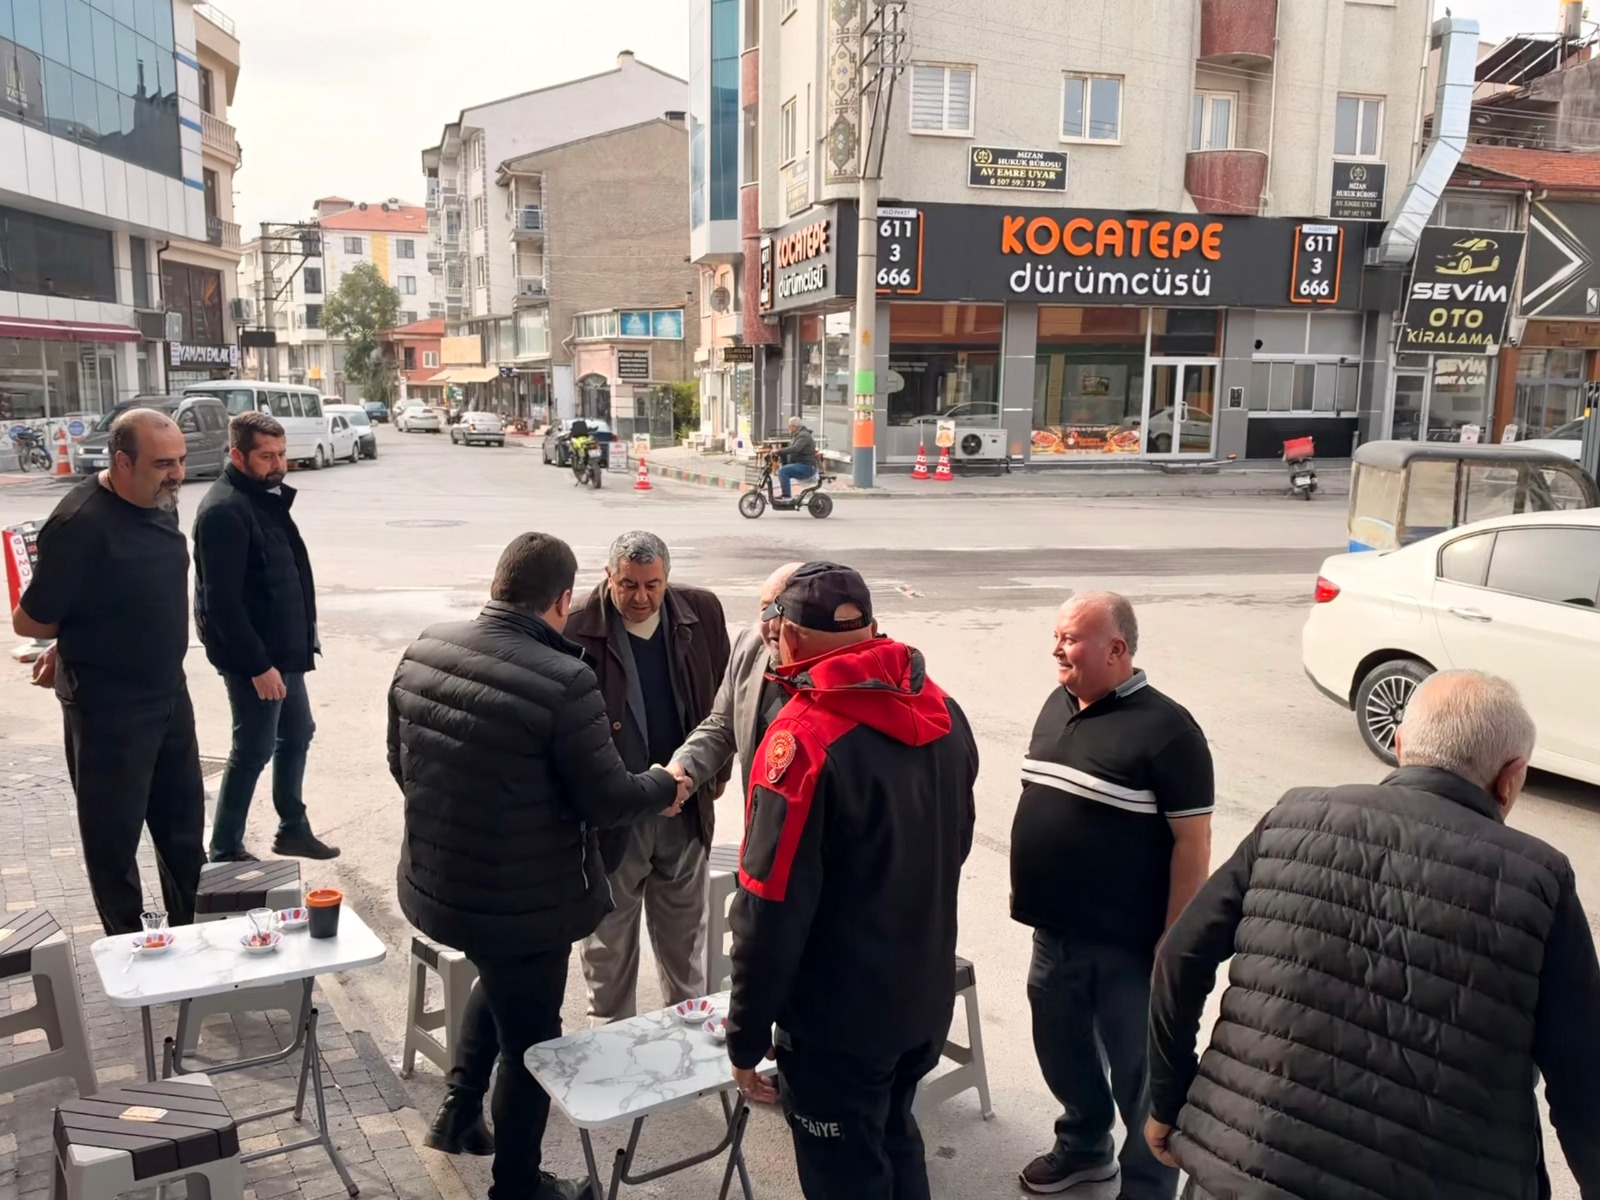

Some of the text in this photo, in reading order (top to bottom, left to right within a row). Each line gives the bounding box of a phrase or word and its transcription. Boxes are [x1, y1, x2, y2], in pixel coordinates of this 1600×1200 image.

[998, 158, 1061, 168] HUKUK BÜROSU
[1017, 151, 1044, 159] MİZAN
[997, 168, 1026, 178] EMRE
[1028, 170, 1056, 179] UYAR
[997, 178, 1010, 186] 507
[880, 219, 912, 238] 611
[1001, 214, 1224, 261] KOCATEPE
[776, 219, 828, 269] KOCATEPE
[889, 244, 901, 262] 3
[1305, 236, 1333, 252] 611
[1311, 257, 1322, 274] 3
[778, 264, 824, 298] dürümcüsü
[877, 267, 911, 286] 666
[1009, 262, 1212, 297] dürümcüsü
[1300, 279, 1329, 296] 666
[1411, 280, 1507, 303] SEVİM
[1429, 307, 1483, 328] OTO
[1407, 328, 1494, 345] KİRALAMA
[207, 346, 229, 363] EMLAK
[1435, 356, 1488, 376] SEVİM
